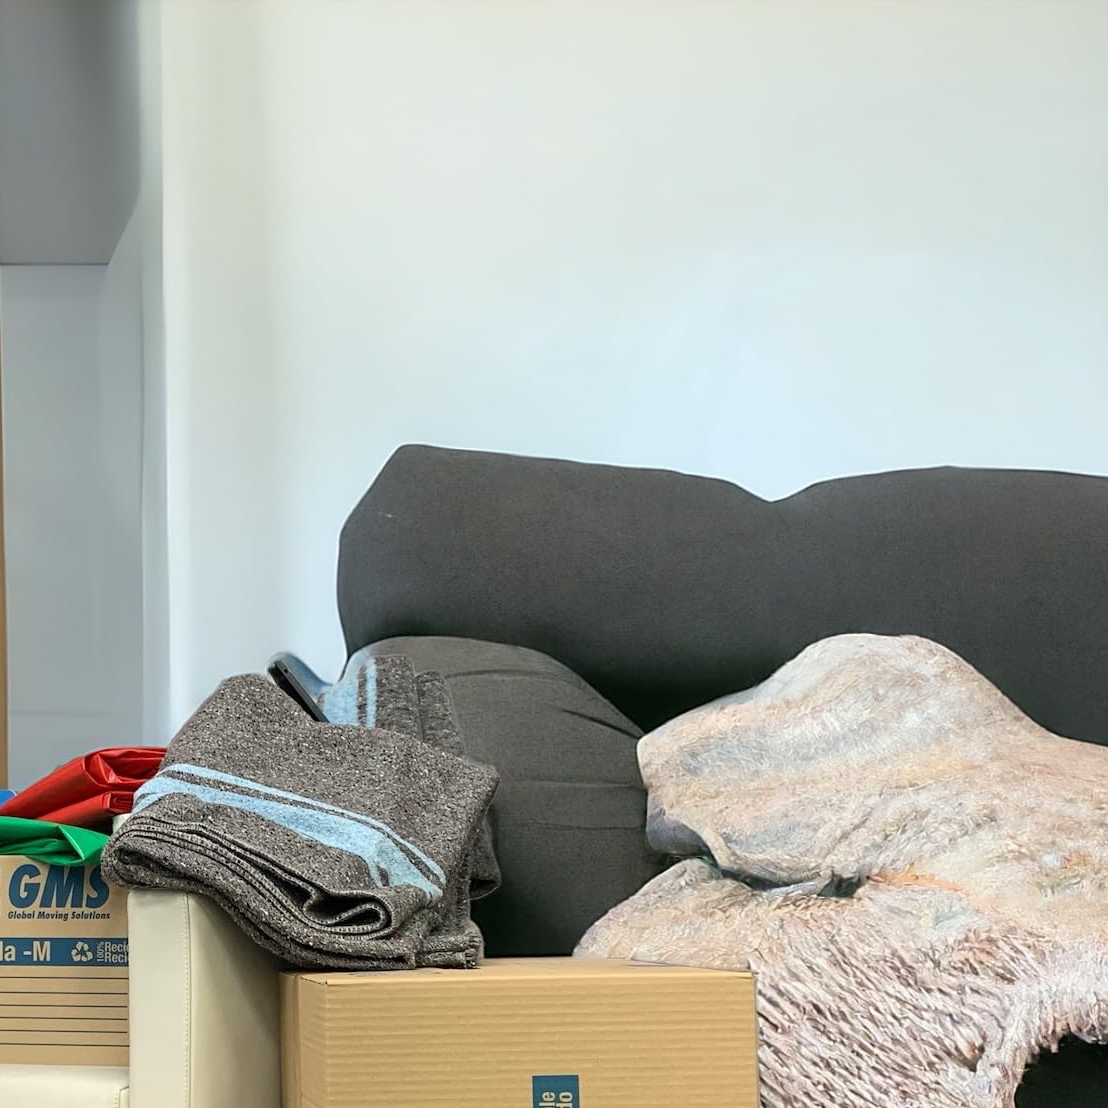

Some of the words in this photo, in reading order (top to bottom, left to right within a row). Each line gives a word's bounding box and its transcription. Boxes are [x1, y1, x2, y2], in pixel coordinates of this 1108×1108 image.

[8, 863, 110, 909] GMS
[8, 911, 35, 920] Global
[37, 911, 68, 922] Moving
[71, 911, 110, 920] Solutions
[23, 940, 51, 962] -M
[96, 941, 105, 962] 100%
